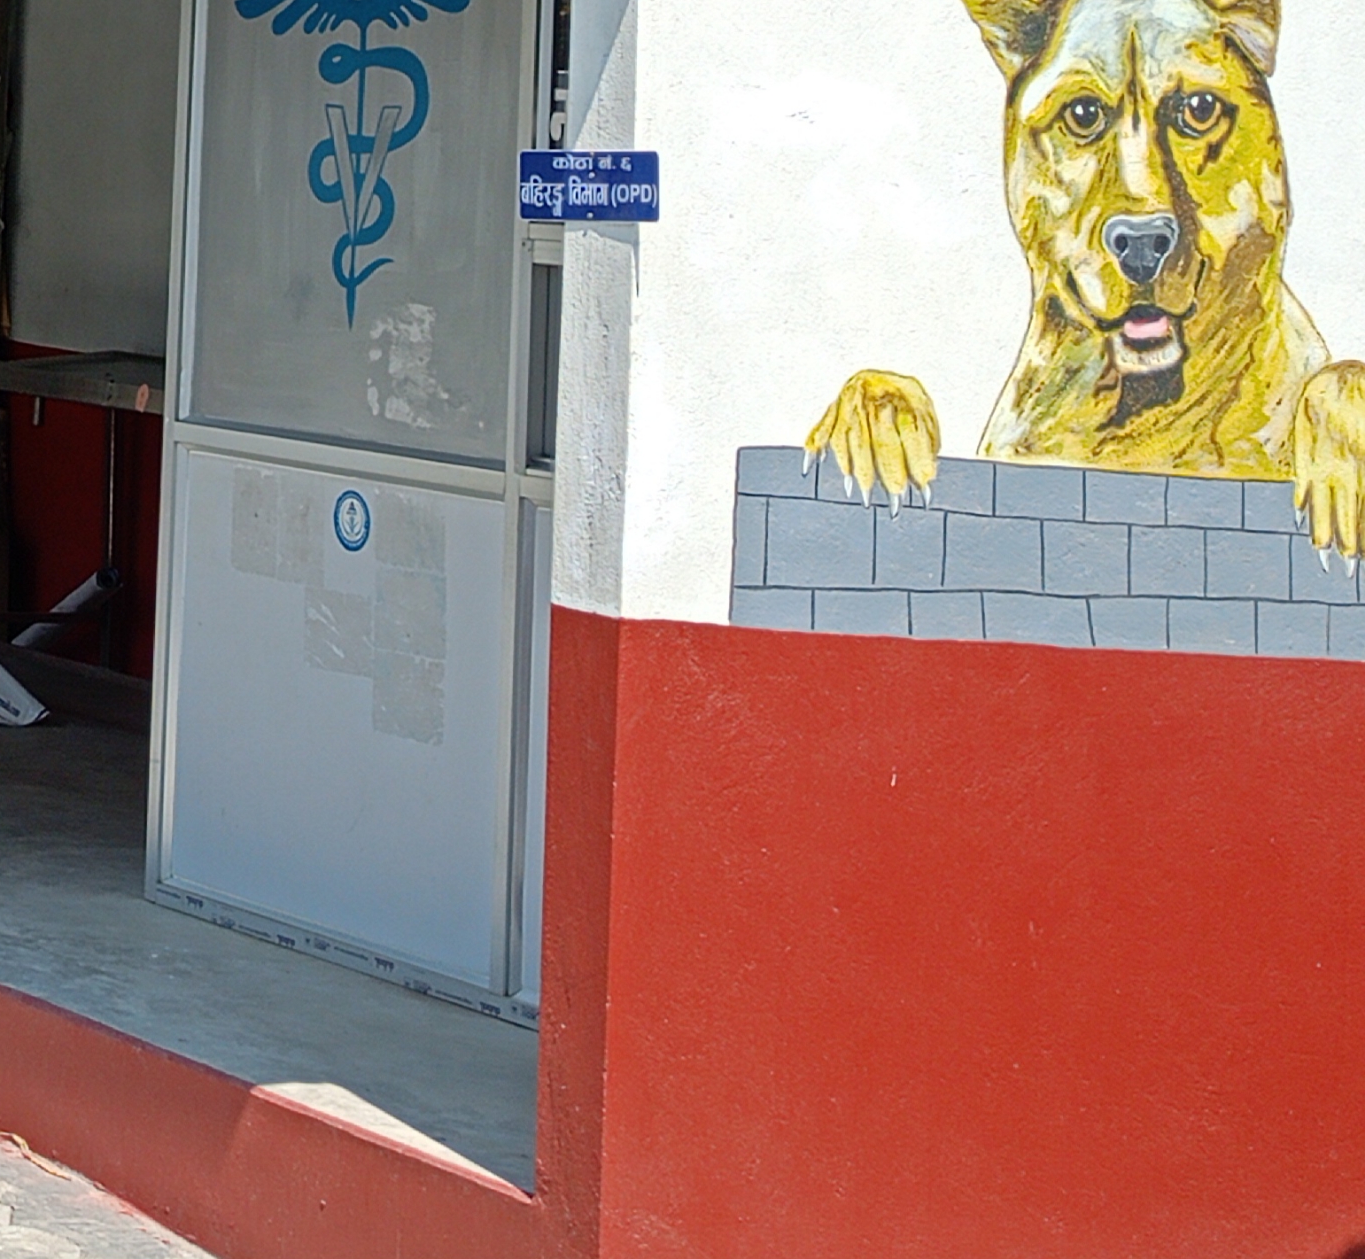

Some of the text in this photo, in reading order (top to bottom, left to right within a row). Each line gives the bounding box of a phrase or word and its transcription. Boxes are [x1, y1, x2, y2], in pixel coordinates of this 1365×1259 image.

[552, 153, 593, 170] कोठा
[569, 175, 609, 207] विभाग
[611, 183, 657, 208] (OPD)
